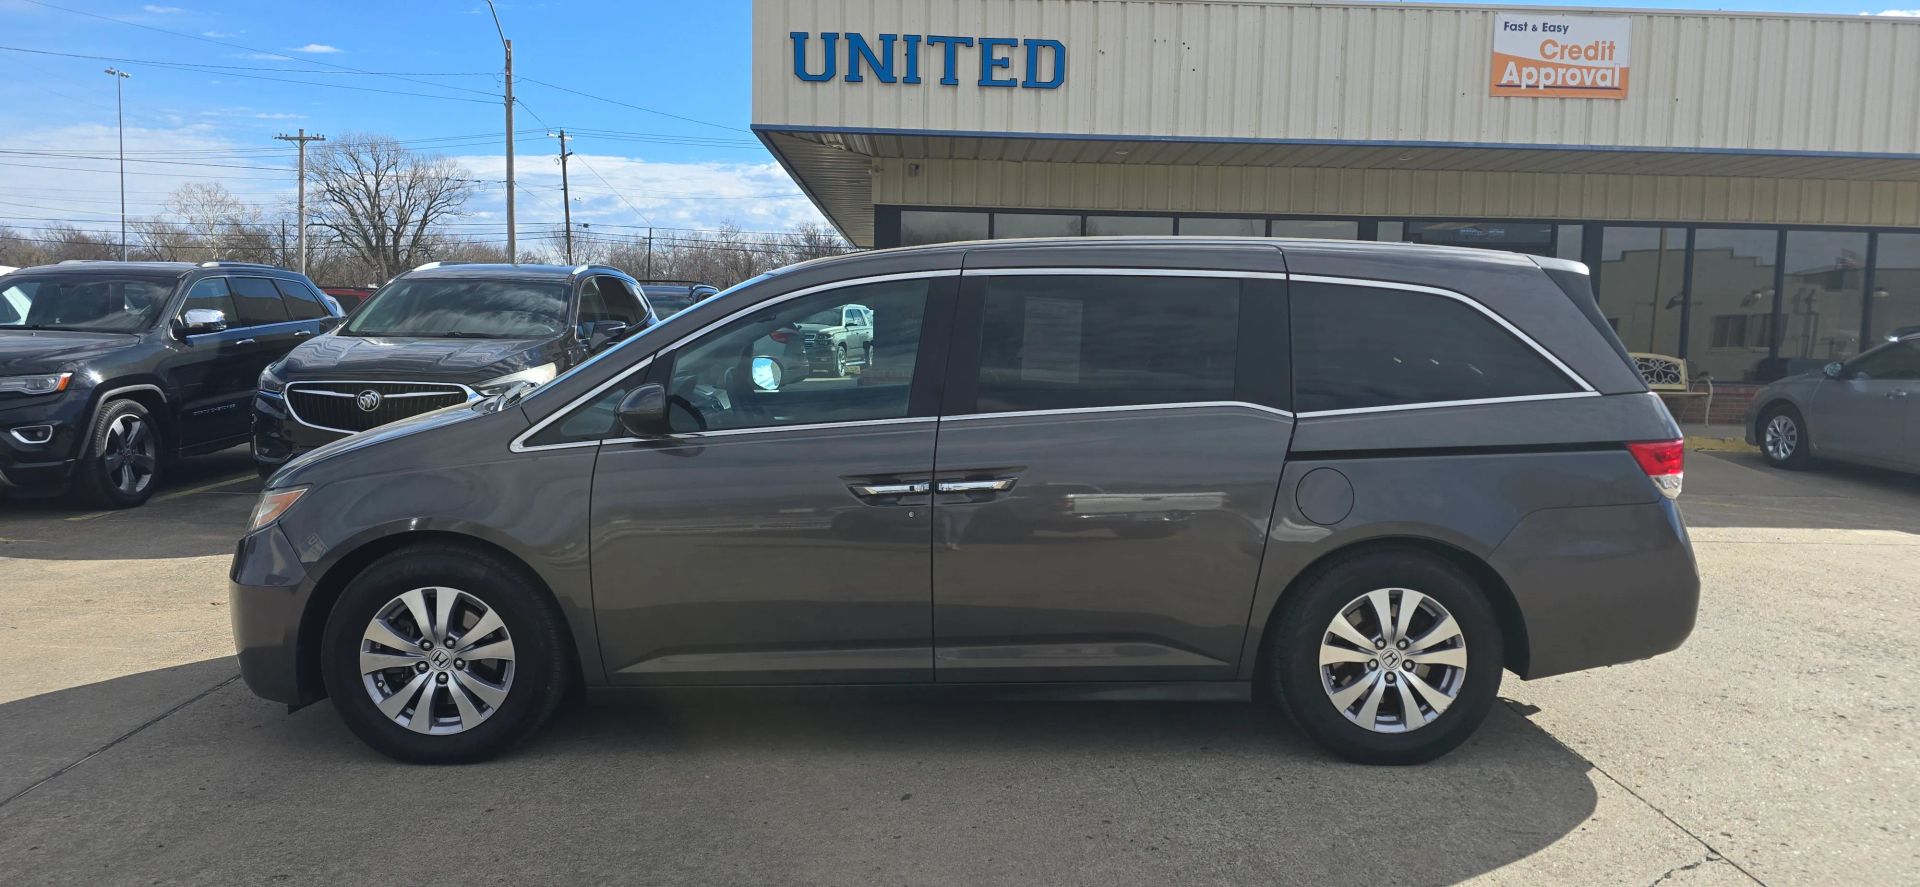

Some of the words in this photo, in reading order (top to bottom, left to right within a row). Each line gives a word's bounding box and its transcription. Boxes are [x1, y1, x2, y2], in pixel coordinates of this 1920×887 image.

[1503, 21, 1528, 32] Fast
[1531, 24, 1538, 32] &
[1542, 22, 1569, 35] Easy
[790, 31, 1066, 89] UNITED
[1540, 38, 1616, 61] Credit
[1501, 61, 1620, 90] Approval
